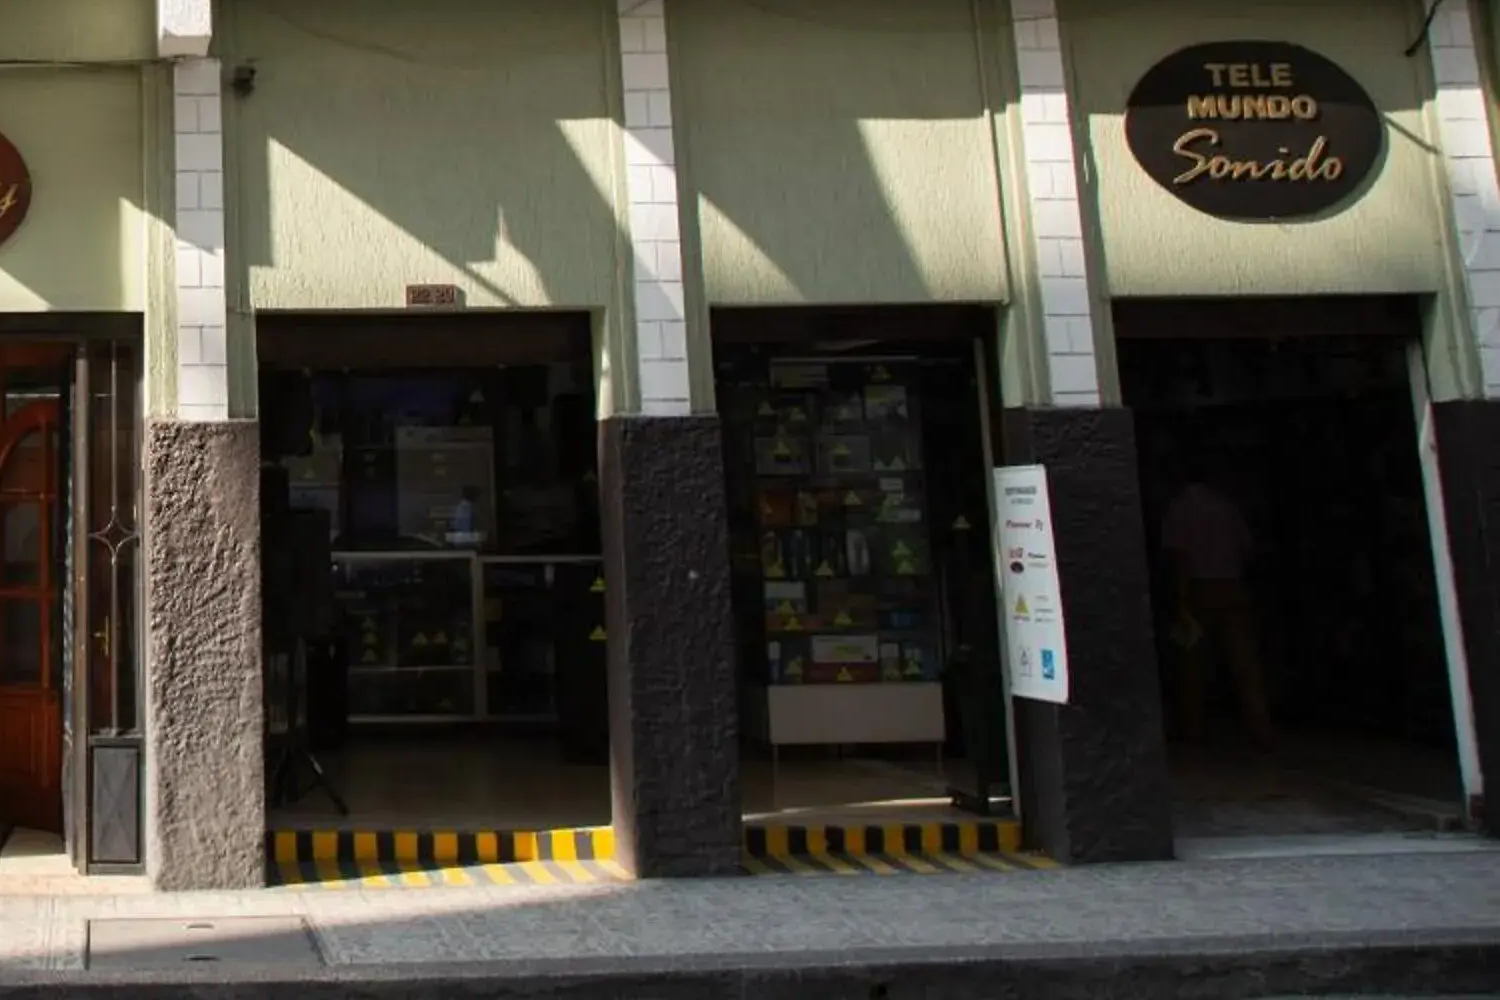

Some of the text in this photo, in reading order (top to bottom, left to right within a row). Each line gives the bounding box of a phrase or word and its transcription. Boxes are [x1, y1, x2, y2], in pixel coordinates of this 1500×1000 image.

[1204, 63, 1293, 87] TELE
[1186, 94, 1318, 119] MUNDO
[1173, 128, 1346, 184] Sonido
